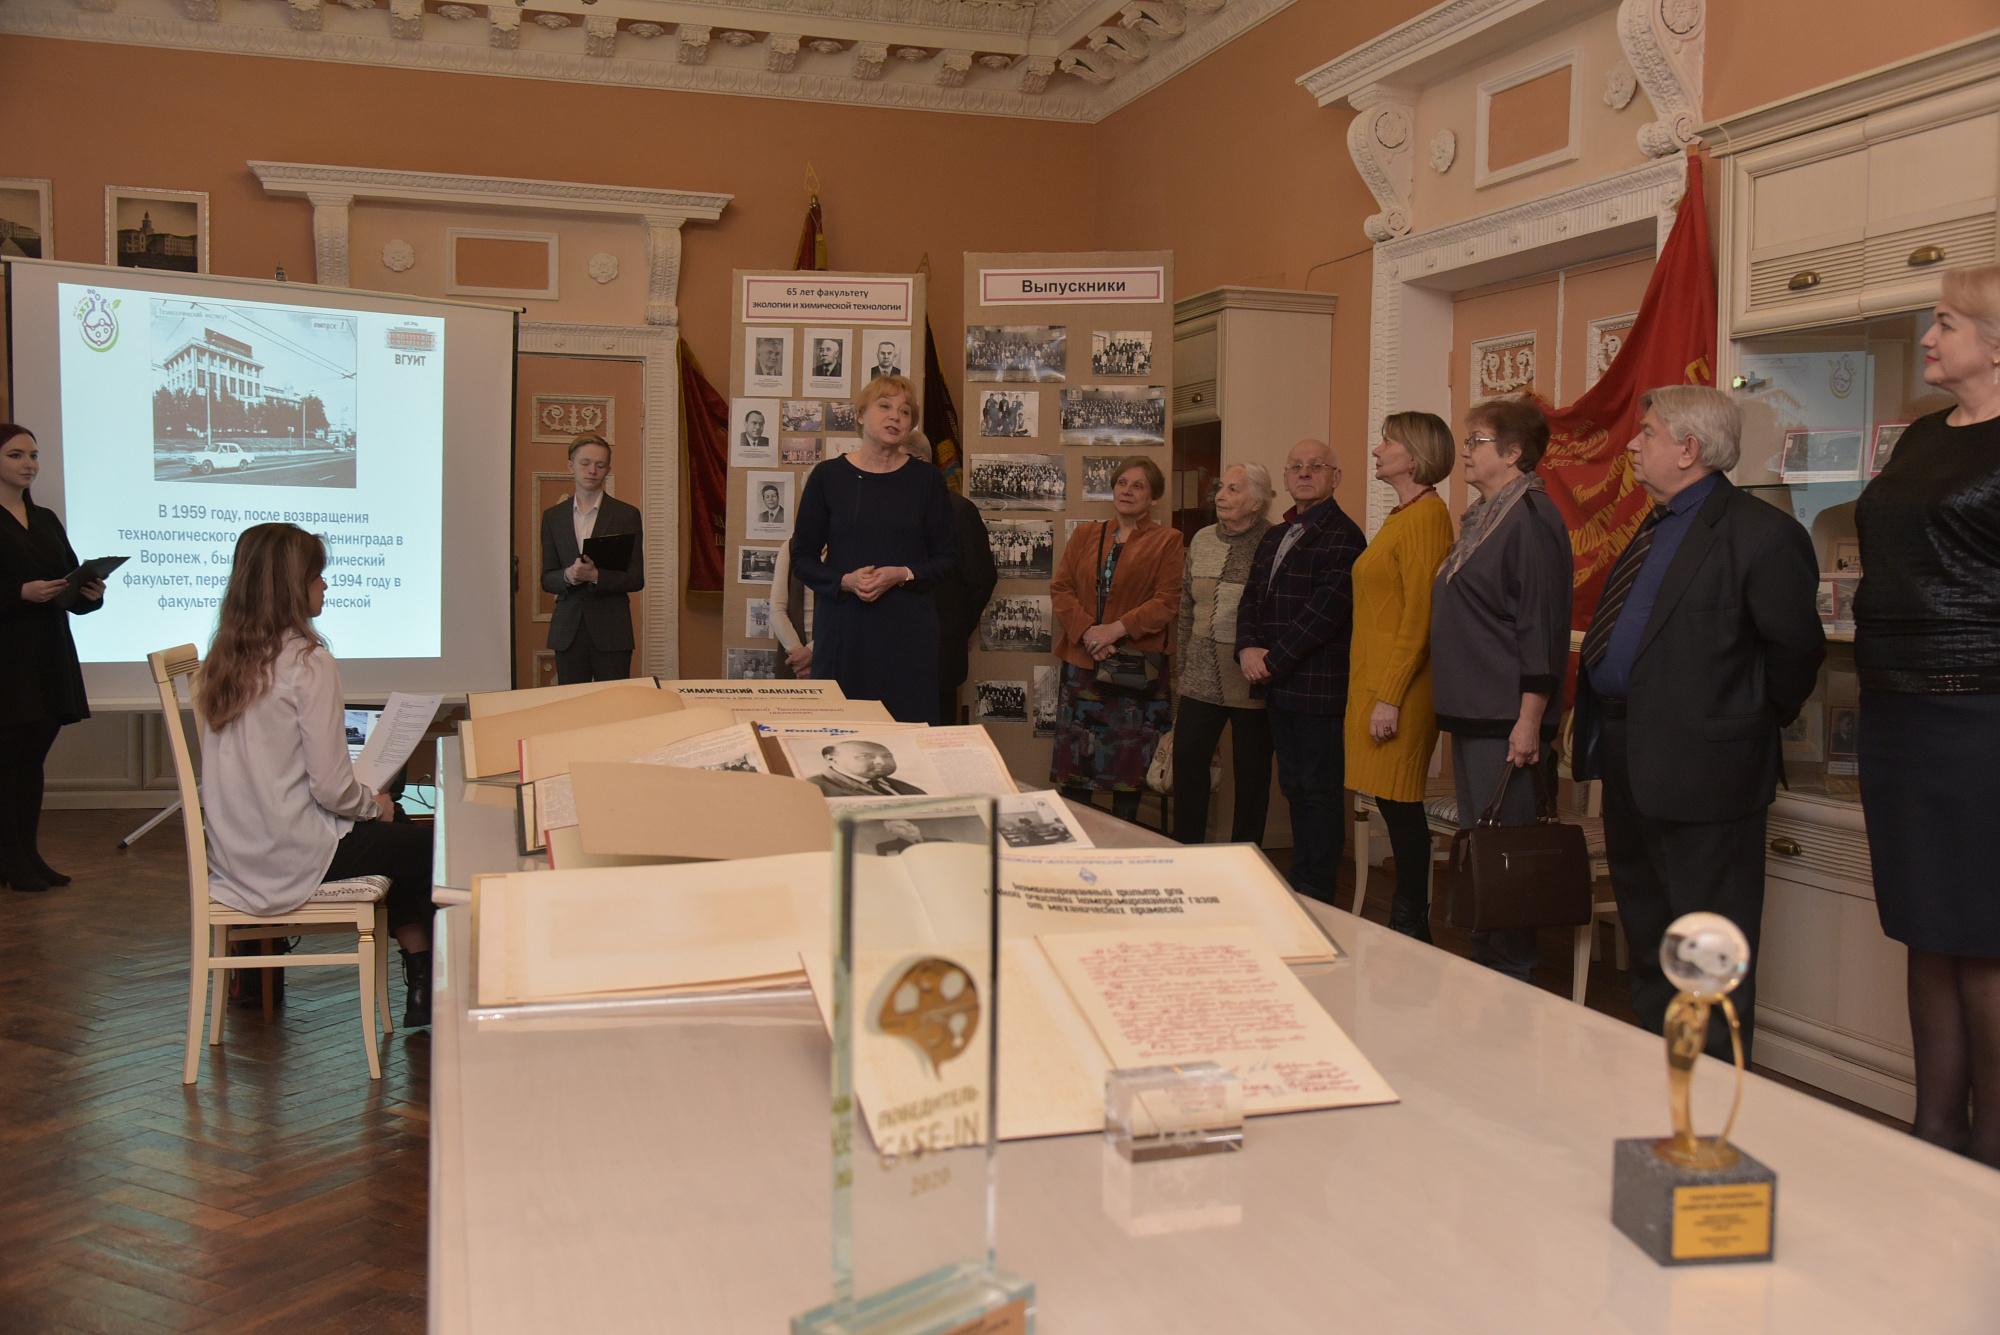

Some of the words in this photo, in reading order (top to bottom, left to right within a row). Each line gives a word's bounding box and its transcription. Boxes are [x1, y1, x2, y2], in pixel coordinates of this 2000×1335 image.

[786, 288, 797, 296] 65
[817, 288, 869, 299] факультету
[1022, 279, 1126, 295] Выпускники
[752, 301, 791, 309] экологии
[800, 302, 852, 311] химической
[853, 303, 902, 311] технологии
[395, 354, 426, 366] ВГУИТ
[159, 504, 168, 518] В
[172, 504, 207, 519] 1959
[211, 508, 241, 523] году,
[244, 510, 281, 522] после
[284, 511, 369, 525] возвращения
[118, 529, 237, 542] технологического
[397, 535, 404, 546] в
[140, 549, 201, 566] Воронеж
[123, 571, 192, 588] факультет,
[331, 573, 363, 587] 1994
[366, 577, 391, 590] году
[395, 577, 402, 587] в
